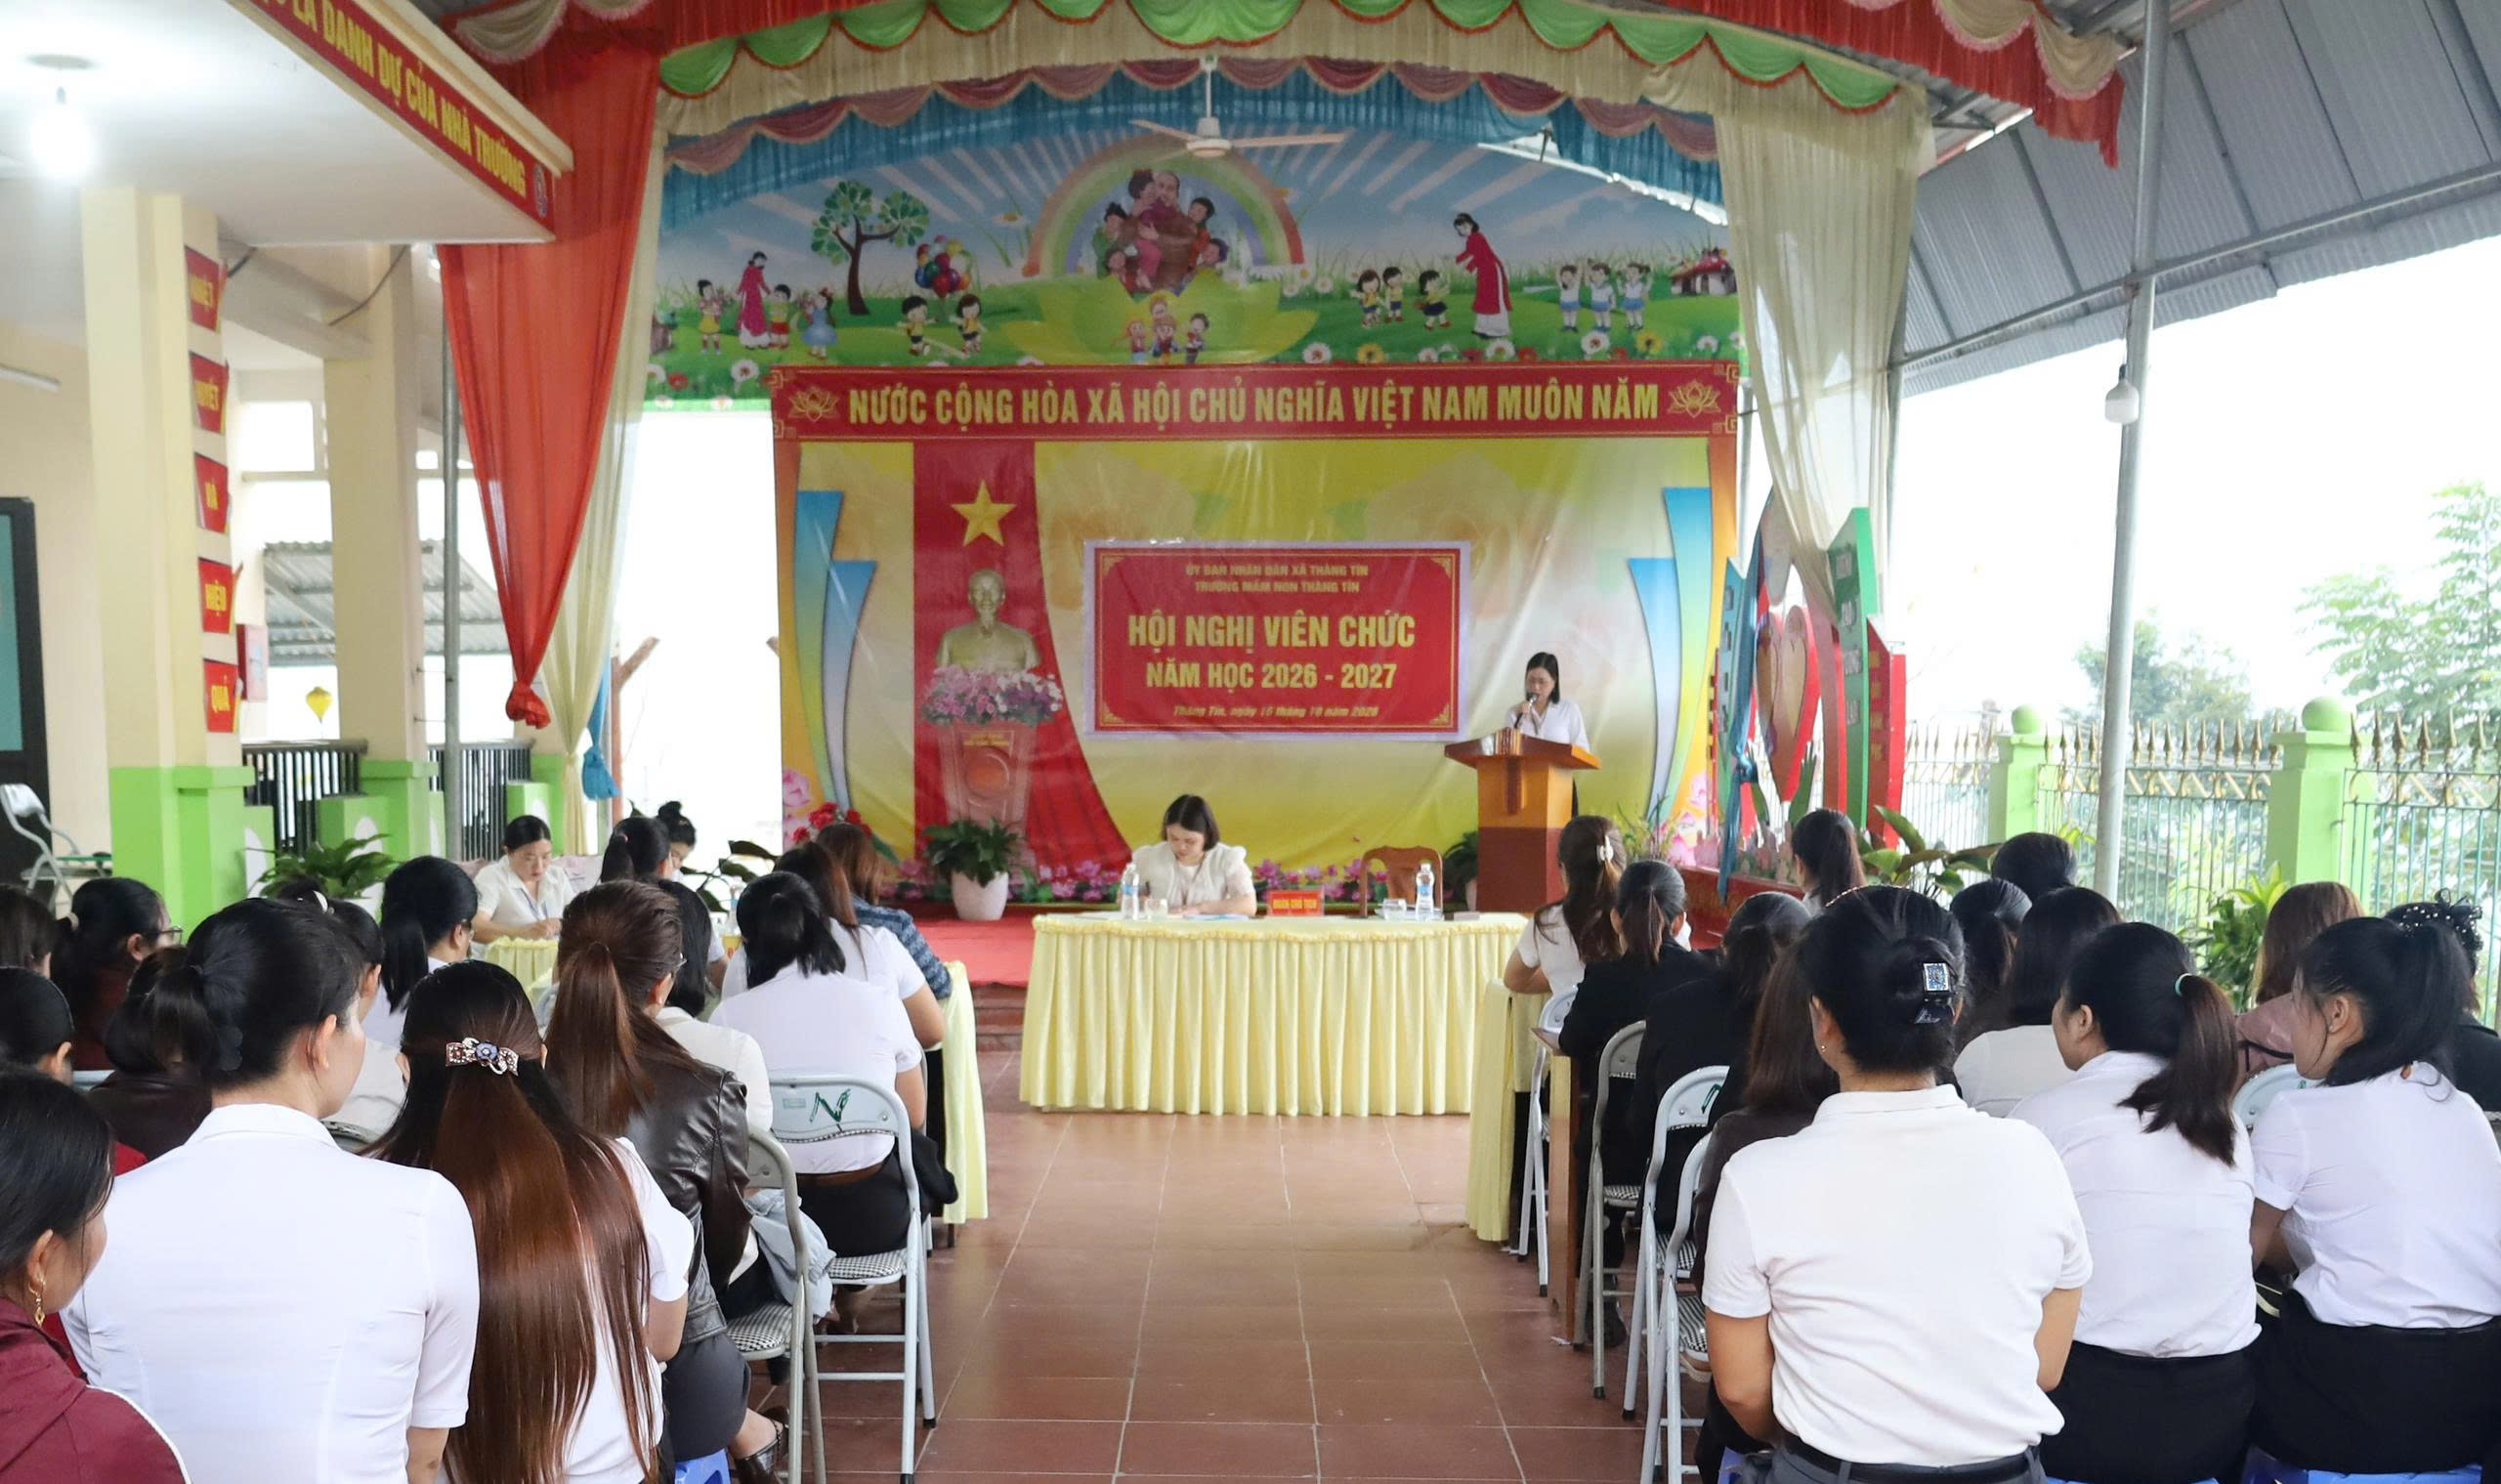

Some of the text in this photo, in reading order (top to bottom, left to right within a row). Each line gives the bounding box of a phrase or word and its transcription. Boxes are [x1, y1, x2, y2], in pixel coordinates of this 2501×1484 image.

[322, 0, 374, 78] DANH
[405, 61, 439, 130] CỦA
[441, 97, 473, 157] NHÀ
[474, 124, 527, 199] TRƯỜNG
[848, 375, 1659, 432] NƯỚC CỘNG HÒA XÃ HỘI CHỦ NGHĨA VIỆT NAM MUÔN NĂM
[1127, 609, 1416, 654] HỘI NGHỊ VIÊN CHỨC
[1146, 658, 1201, 689] NĂM
[1208, 662, 1254, 694] HỌC
[1261, 663, 1318, 689] 2026
[1340, 663, 1397, 689] 2027
